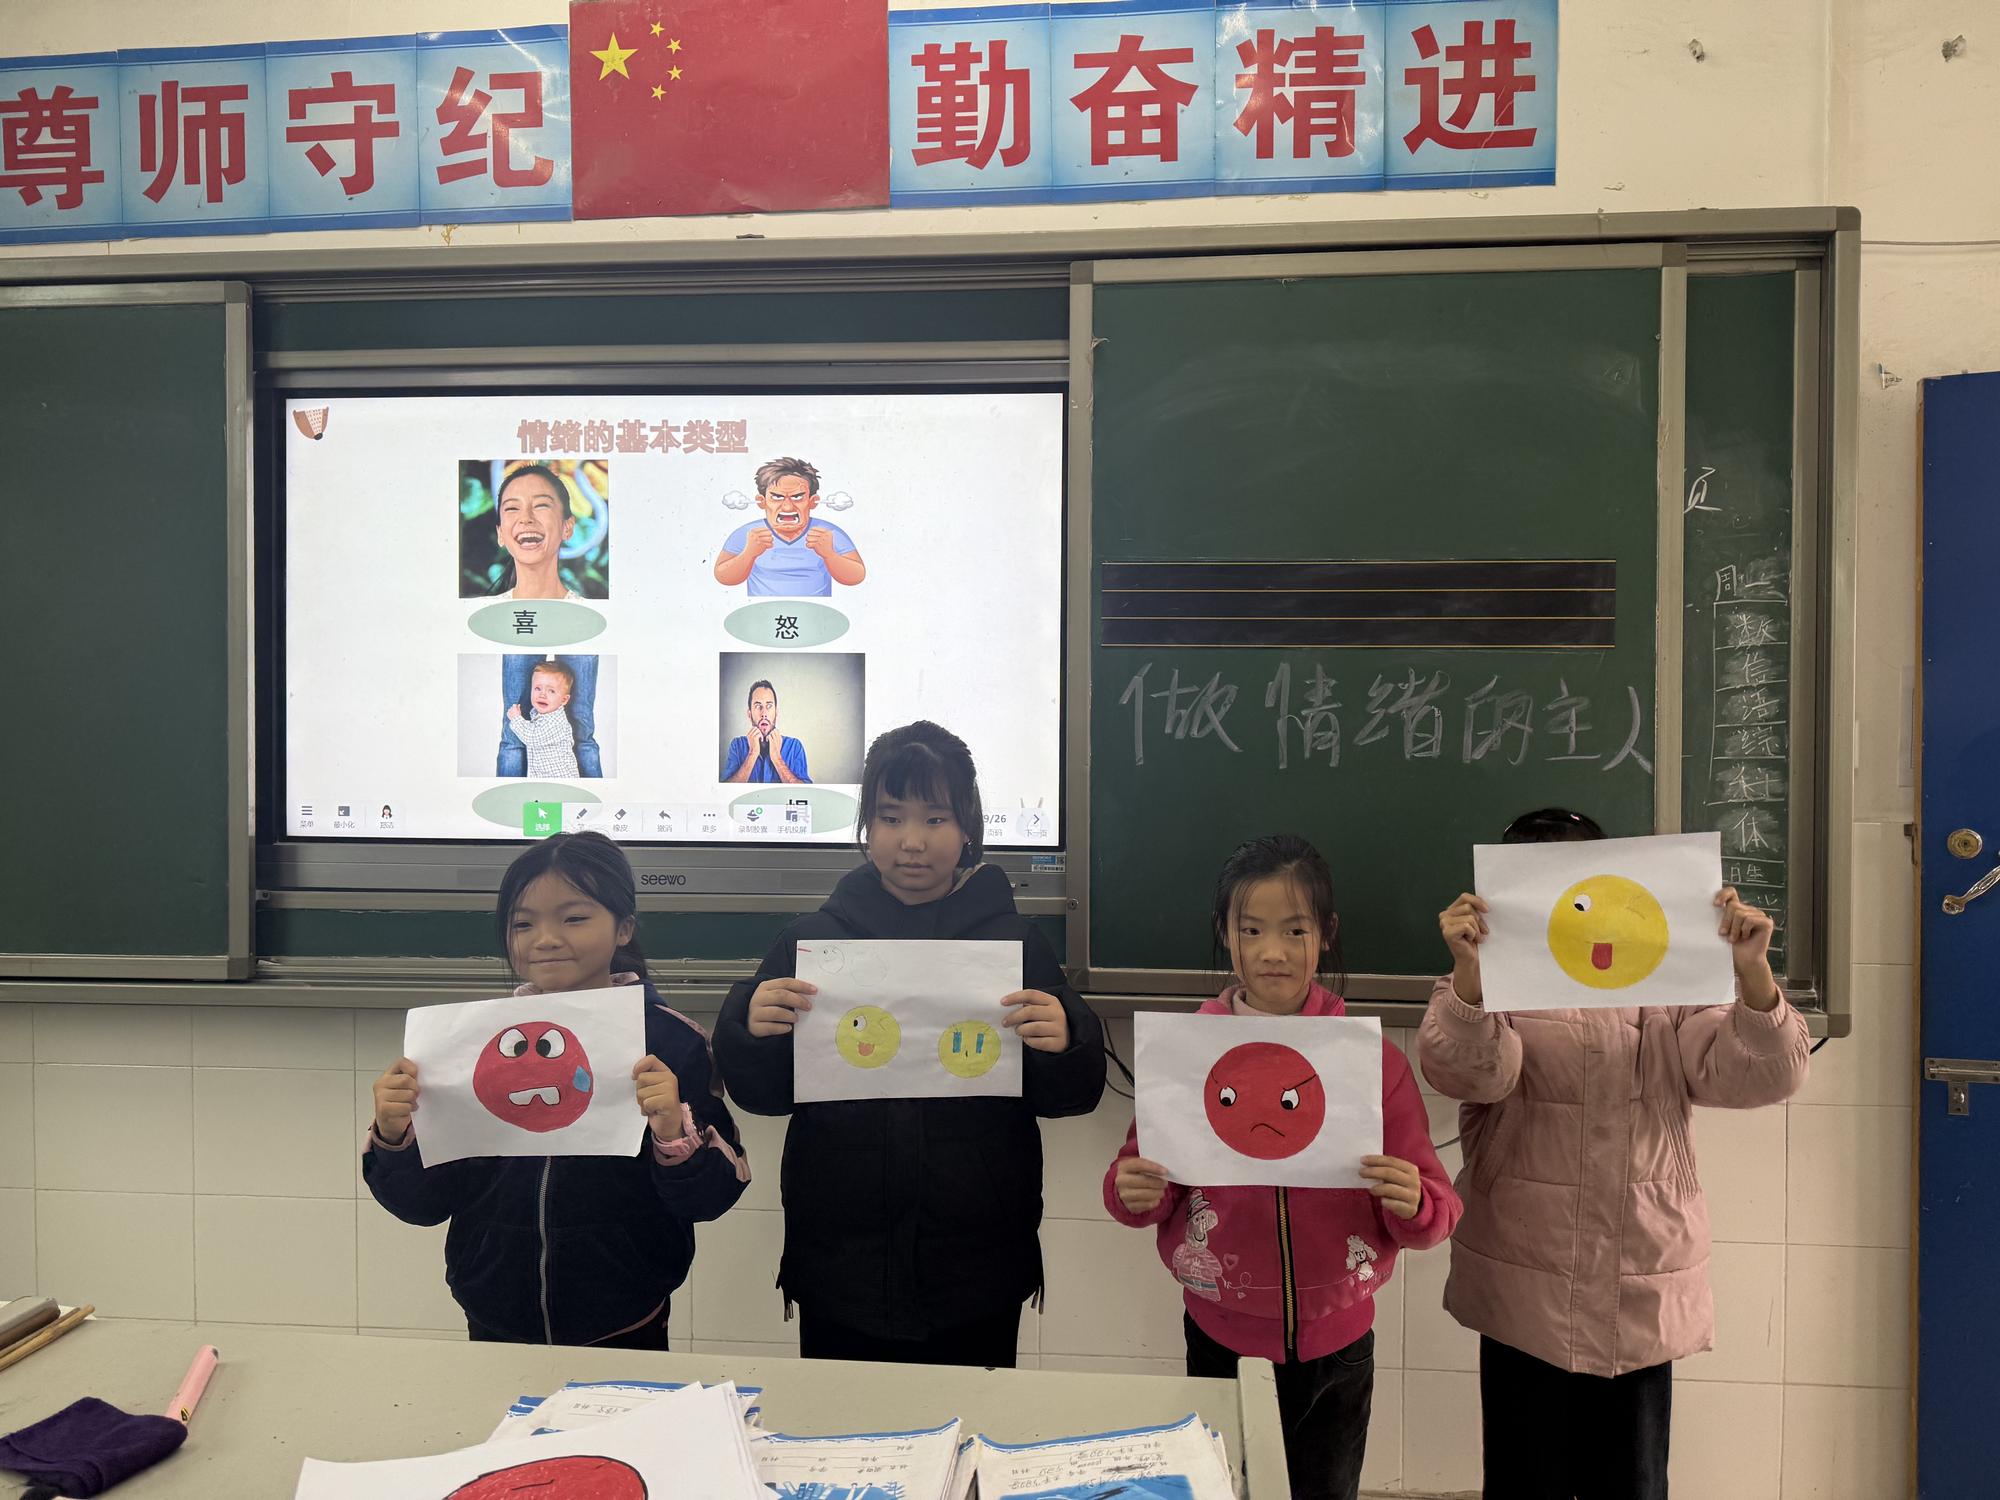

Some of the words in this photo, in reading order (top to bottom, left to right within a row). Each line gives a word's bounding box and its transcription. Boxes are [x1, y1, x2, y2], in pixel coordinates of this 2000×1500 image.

[911, 18, 1537, 170] 勤奋精进
[0, 66, 554, 210] 尊师守纪
[517, 419, 749, 453] 情绪的基本类型
[512, 610, 538, 635] 喜
[775, 614, 800, 639] 怒
[1119, 661, 1654, 775] 做情绪的主人
[640, 874, 687, 886] seewo
